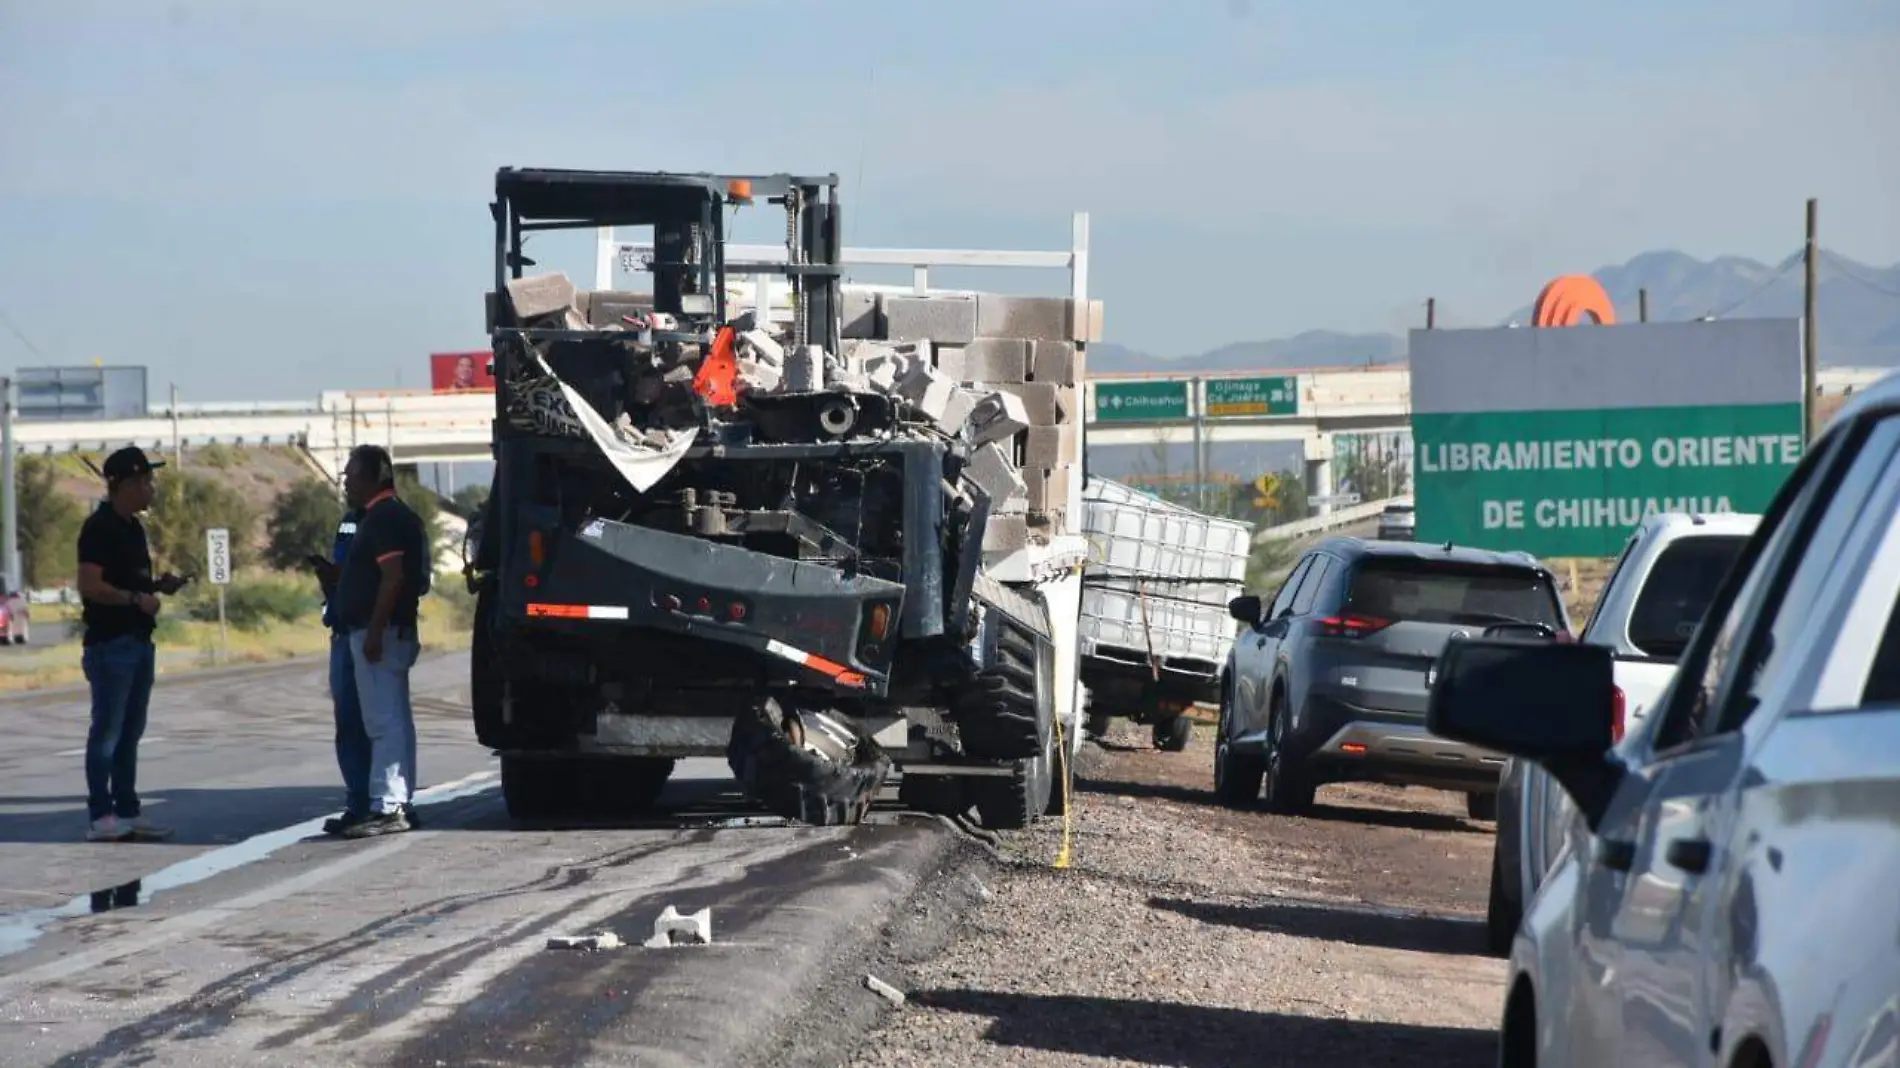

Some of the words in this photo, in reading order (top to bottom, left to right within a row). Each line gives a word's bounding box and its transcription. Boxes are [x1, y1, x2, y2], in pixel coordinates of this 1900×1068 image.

[1125, 394, 1185, 407] Chihuahua
[1420, 438, 1642, 472] LIBRAMIENTO
[1652, 435, 1800, 468] ORIENTE
[1483, 500, 1524, 529] DE
